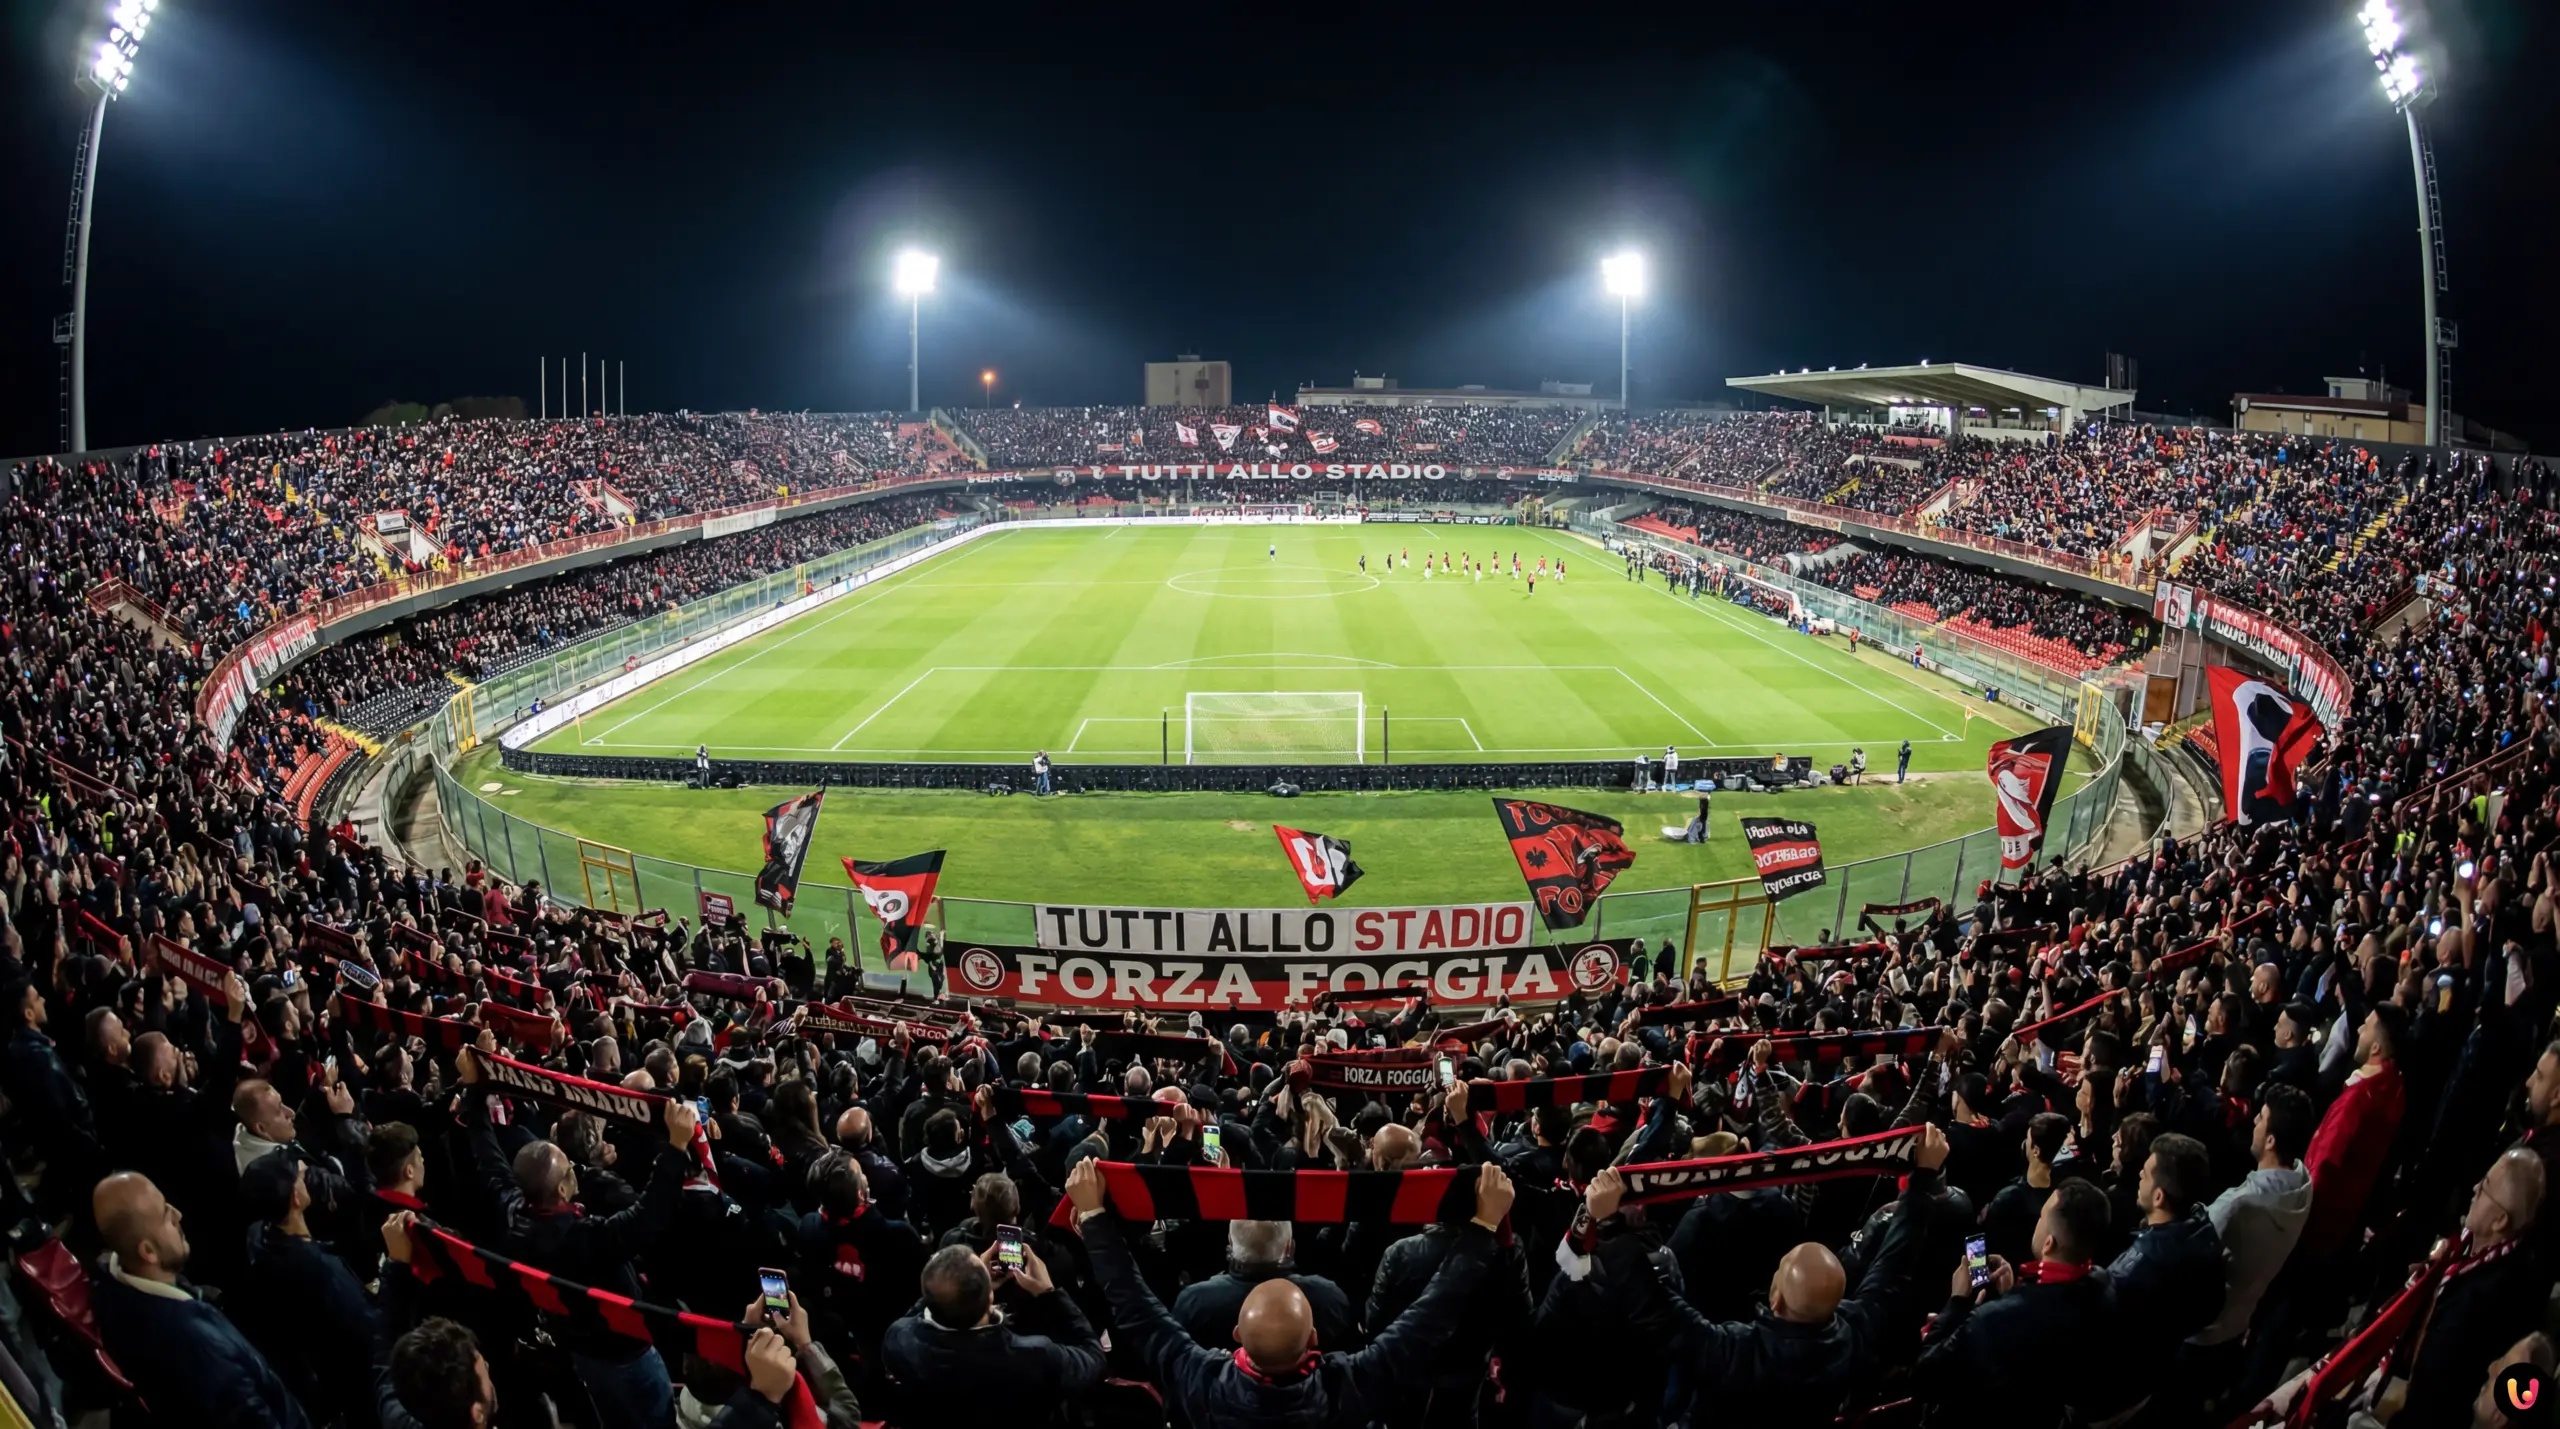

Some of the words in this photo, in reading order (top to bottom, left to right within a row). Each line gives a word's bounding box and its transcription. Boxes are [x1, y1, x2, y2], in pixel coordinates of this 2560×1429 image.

[1118, 464, 1215, 480] TUTTI
[1226, 464, 1313, 480] ALLO
[1326, 464, 1446, 480] STADIO
[1046, 907, 1185, 951] TUTTI
[1207, 912, 1335, 953] ALLO
[1354, 906, 1525, 951] STADIO
[1015, 954, 1262, 1005] FORZA
[1284, 953, 1559, 1004] FOGGIA
[1344, 1066, 1383, 1085] FORZA
